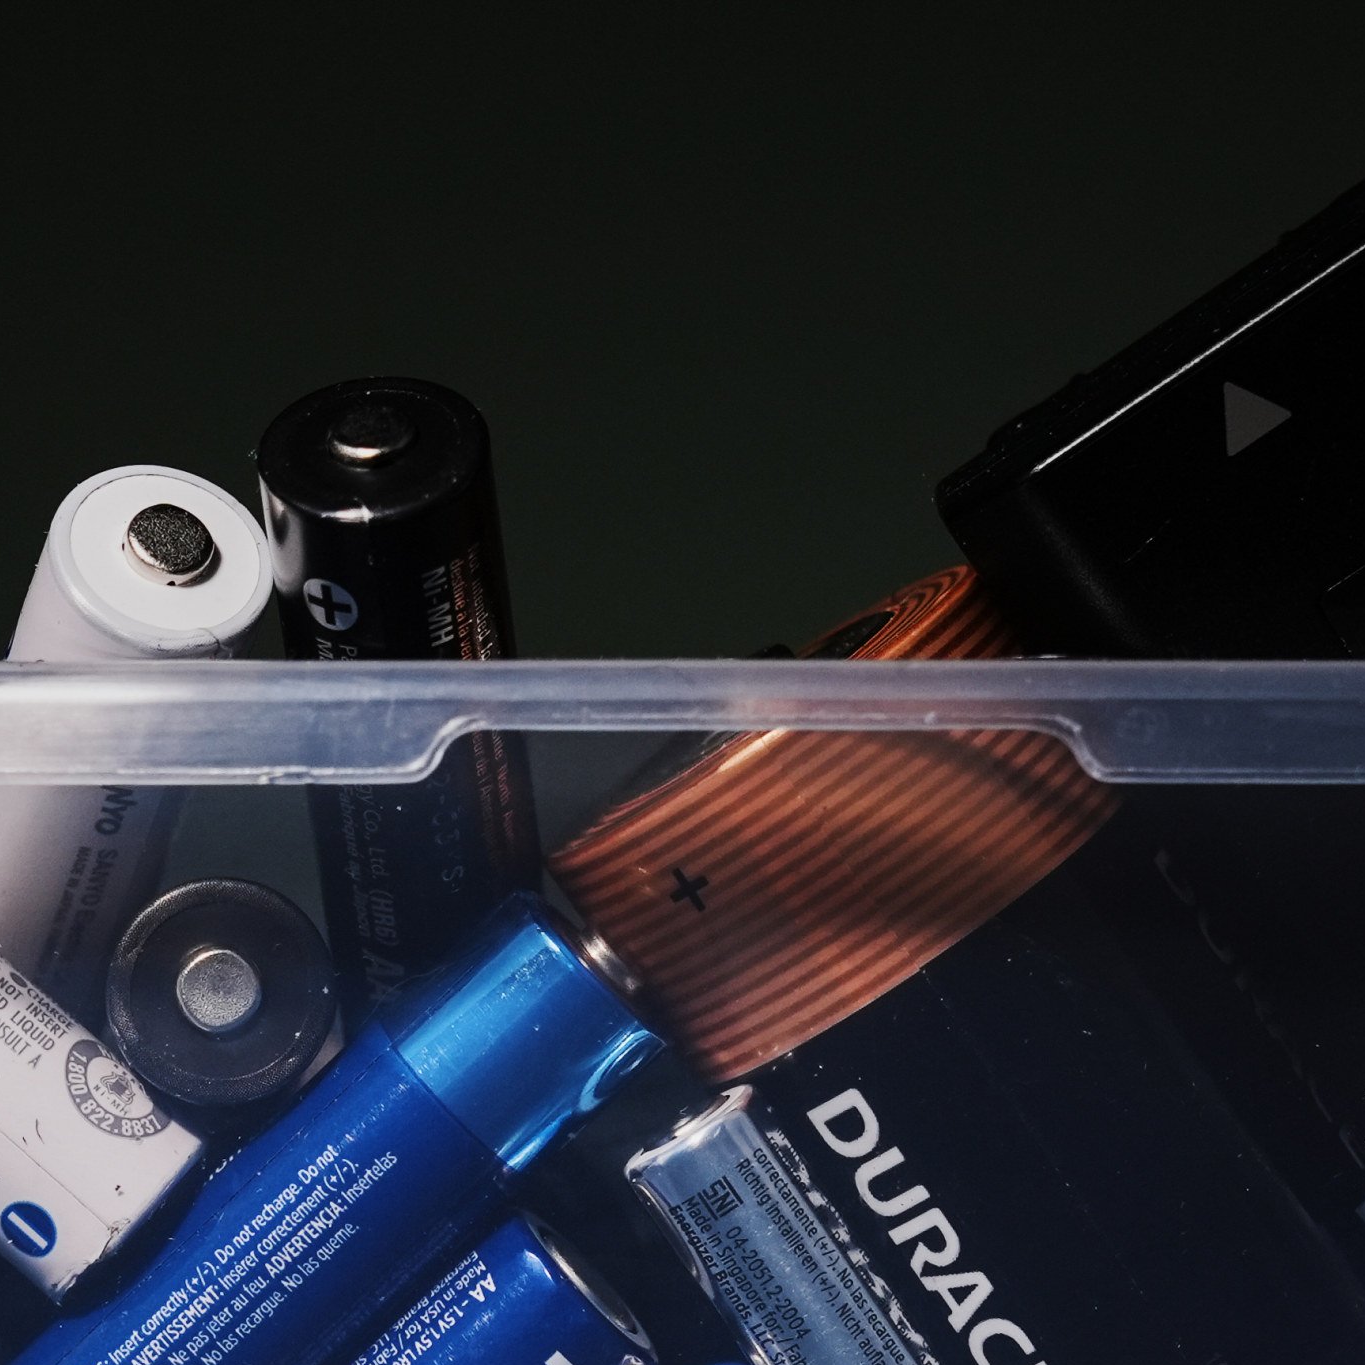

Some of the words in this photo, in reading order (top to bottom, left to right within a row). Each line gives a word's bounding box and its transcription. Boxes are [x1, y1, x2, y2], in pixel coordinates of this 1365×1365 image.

[419, 563, 457, 649] Ni-MH
[80, 846, 121, 913] SANYO
[8, 1008, 57, 1053] LIQUID
[24, 1000, 70, 1041] INSERT
[137, 1285, 191, 1338] correctly
[212, 1241, 237, 1266] Do
[230, 1222, 257, 1251] not
[248, 1179, 306, 1233] recharge.
[295, 1162, 321, 1186] Do
[313, 1142, 341, 1171] not
[215, 1248, 261, 1292] Insérer
[254, 1182, 331, 1257] correctement
[666, 1202, 720, 1274] Energizer
[679, 1193, 715, 1236] Made
[704, 1229, 725, 1250] in
[732, 1156, 774, 1208] Richtig
[763, 1199, 821, 1276] installieren
[833, 1300, 868, 1342] Nicht
[751, 1145, 820, 1240] correctamente
[811, 1234, 843, 1273] (+/-).
[835, 1266, 856, 1291] No
[848, 1285, 870, 1311] las
[183, 1328, 212, 1358] pas
[200, 1304, 236, 1341] jeter
[227, 1291, 251, 1314] au
[240, 1272, 272, 1300] feu.
[338, 1148, 400, 1206] Insértelas
[214, 1330, 241, 1355] las
[232, 1287, 290, 1341] recargue.
[278, 1270, 305, 1294] No
[295, 1254, 322, 1279] las
[313, 1219, 362, 1264] queme.
[466, 1270, 499, 1305] AA
[714, 1243, 770, 1316] Singapore
[723, 1223, 813, 1342] 04-2051.2-2004
[434, 1303, 466, 1336] 1.5V
[759, 1309, 787, 1340] for:
